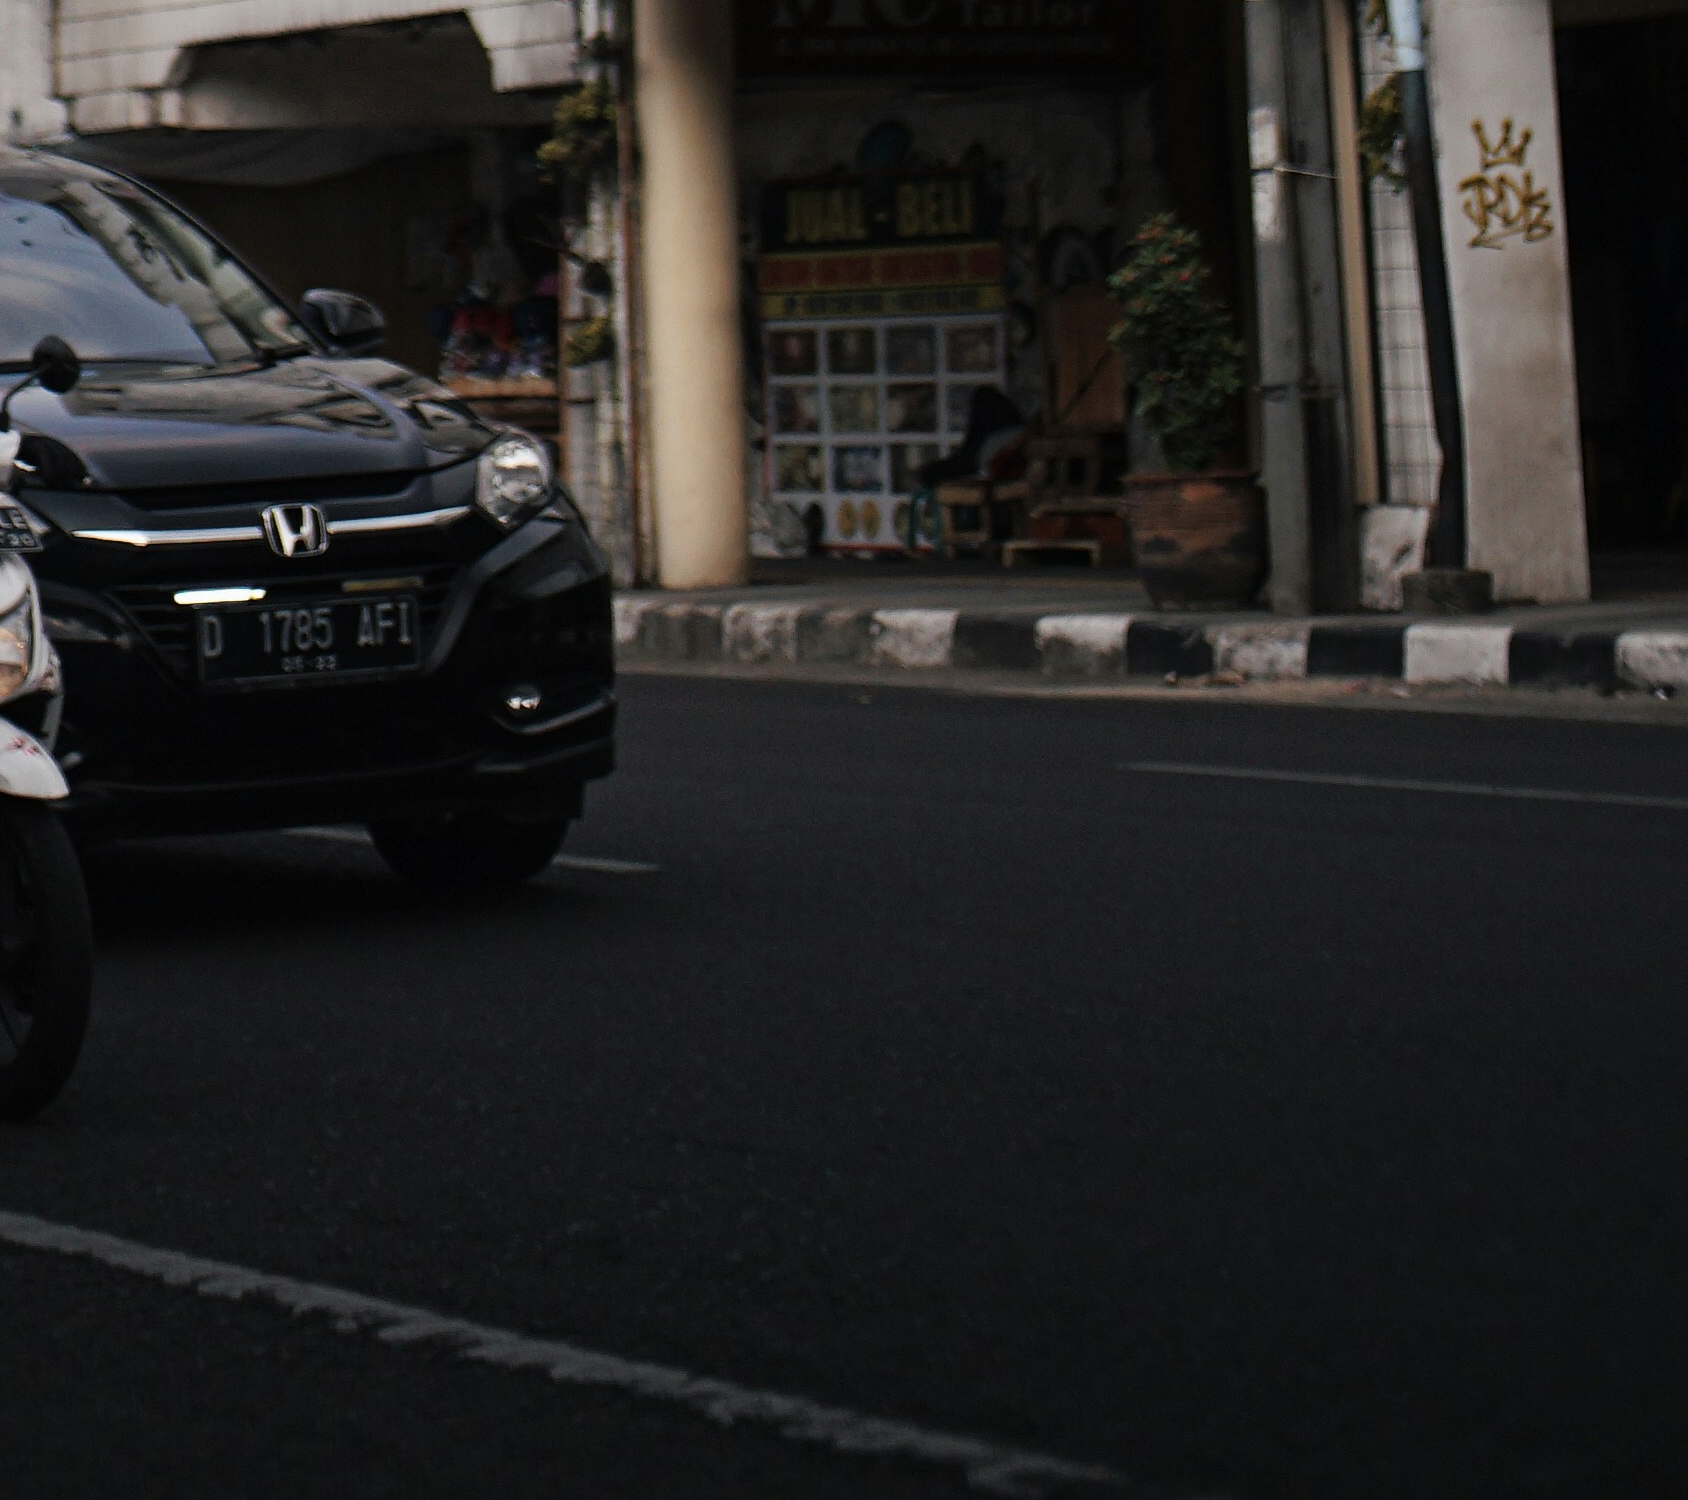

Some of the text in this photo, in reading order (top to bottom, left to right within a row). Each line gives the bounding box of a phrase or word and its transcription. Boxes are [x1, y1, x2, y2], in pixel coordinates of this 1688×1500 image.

[783, 186, 870, 244] JUAL
[895, 180, 976, 239] BELI
[201, 601, 413, 659] D 1785 AFI
